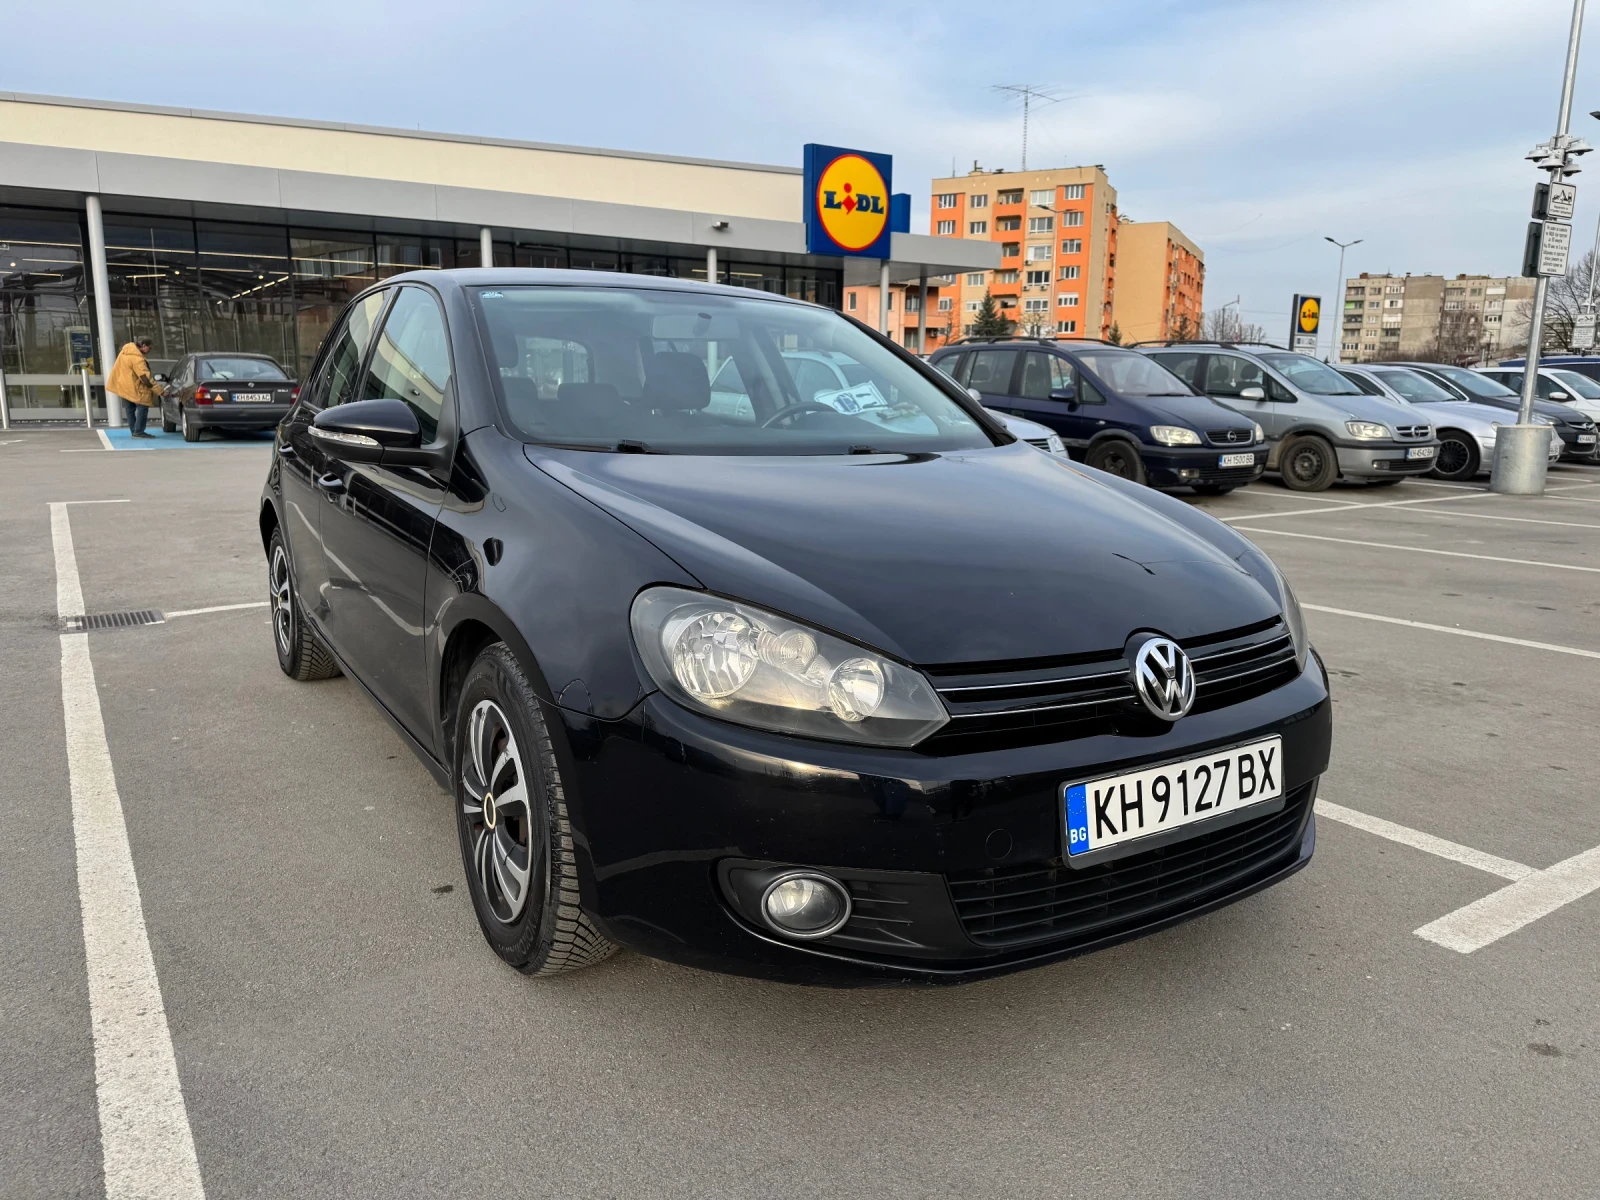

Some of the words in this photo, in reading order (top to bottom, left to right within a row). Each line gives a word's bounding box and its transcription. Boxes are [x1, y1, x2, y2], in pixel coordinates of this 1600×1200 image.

[1223, 456, 1232, 465] KH
[1094, 780, 1144, 839] KH
[1151, 758, 1231, 824] 9127
[1238, 747, 1276, 800] BX
[1070, 827, 1087, 844] BG
